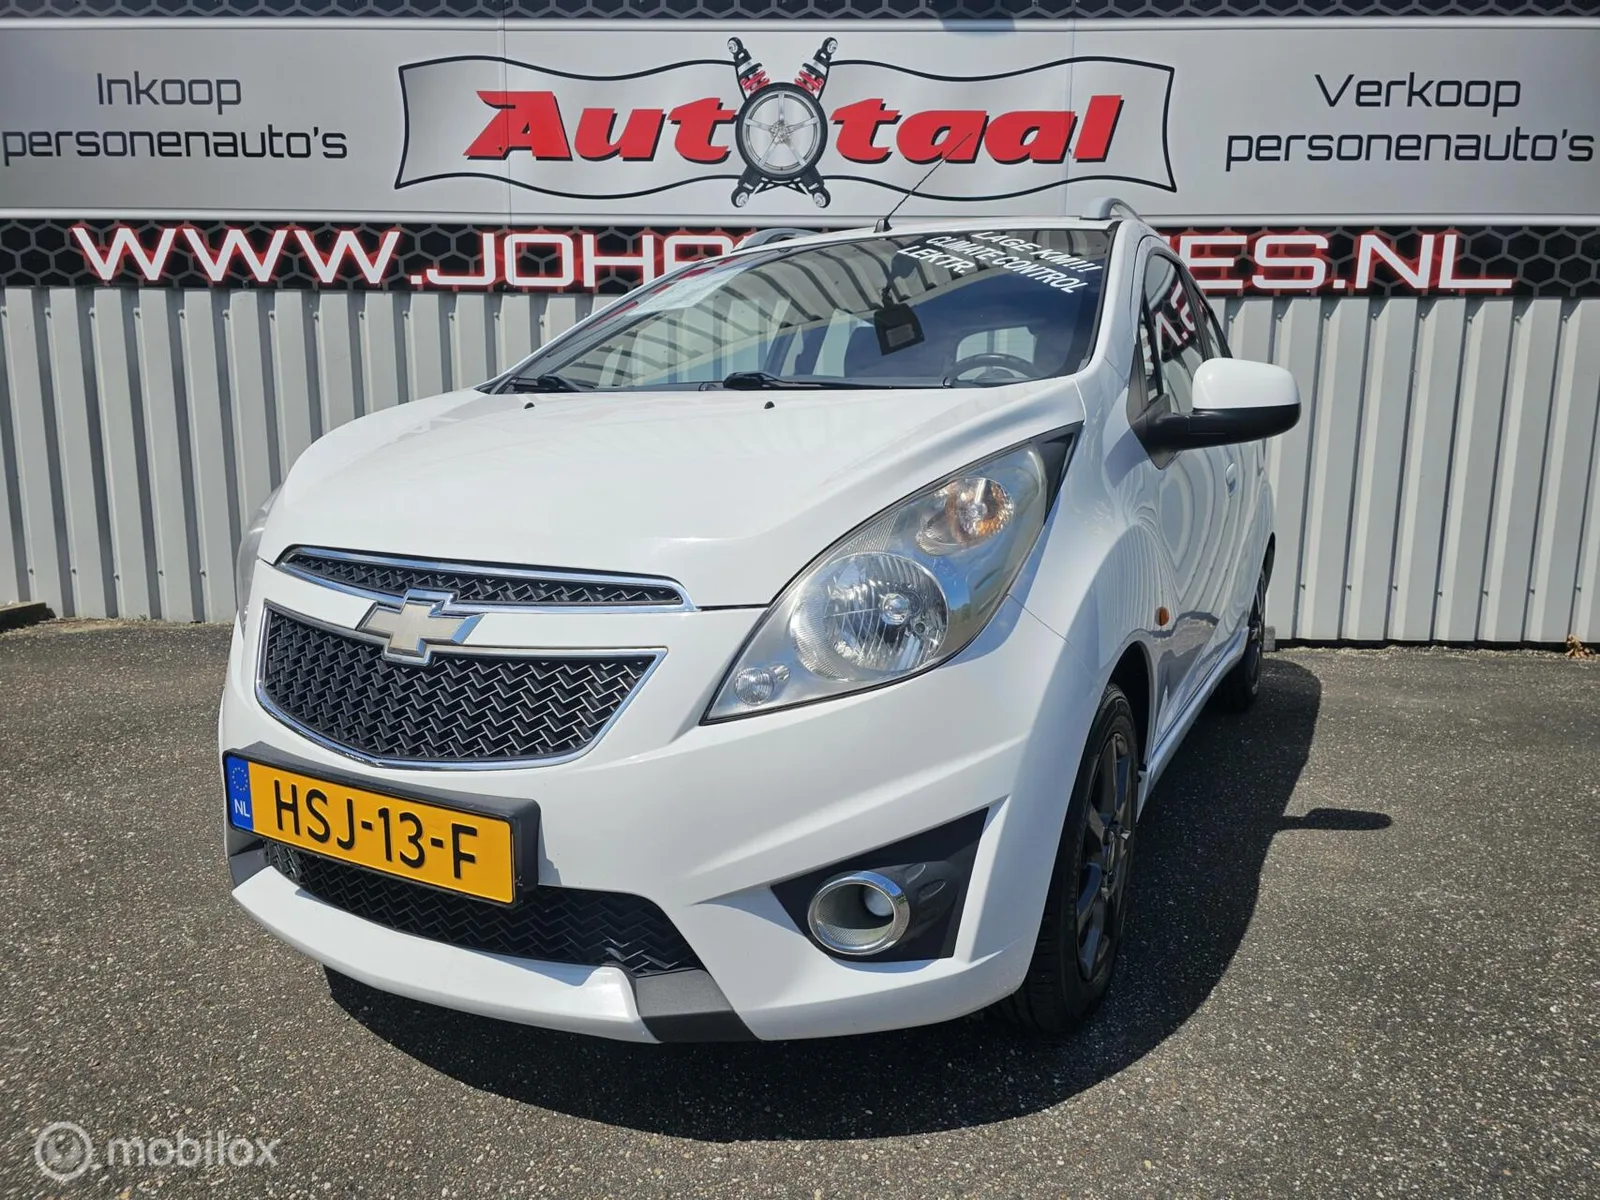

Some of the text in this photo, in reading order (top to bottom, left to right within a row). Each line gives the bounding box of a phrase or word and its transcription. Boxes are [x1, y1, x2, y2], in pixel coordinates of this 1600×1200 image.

[97, 70, 242, 115] Inkoop
[1314, 71, 1521, 116] Verkoop
[3, 124, 347, 166] personenauto's
[1226, 125, 1594, 171] personenauto's
[72, 226, 1513, 291] WWW.JOHA ES.NL
[897, 245, 976, 274] LEKTR.
[926, 236, 1089, 294] CLIMATE CONTROL
[971, 231, 1103, 273] LAGE KM!!!
[233, 798, 251, 817] NL
[274, 779, 478, 880] HSJ-13-F
